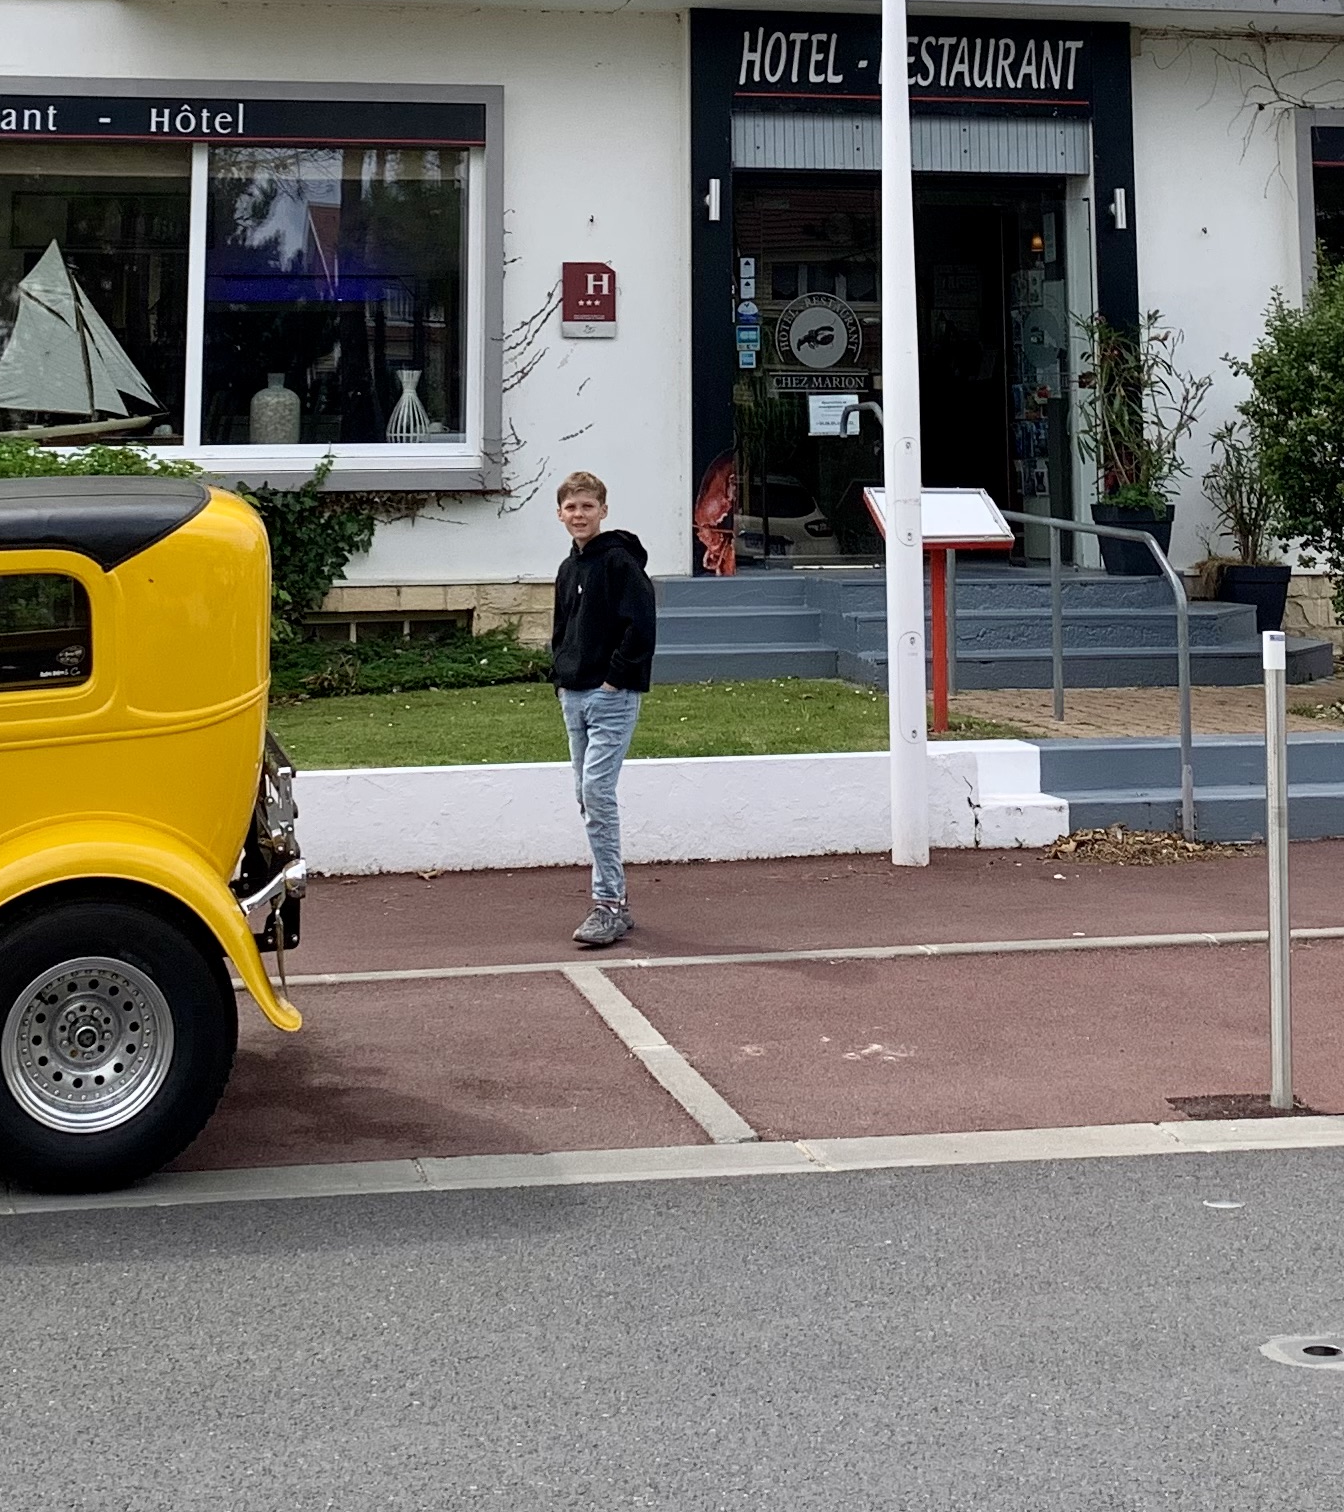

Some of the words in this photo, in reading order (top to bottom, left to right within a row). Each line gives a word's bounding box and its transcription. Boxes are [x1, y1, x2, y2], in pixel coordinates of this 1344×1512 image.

[739, 27, 844, 85] HOTEL
[878, 35, 1084, 90] ESTAURANT
[150, 103, 245, 134] Hôtel
[585, 273, 610, 295] H
[779, 309, 799, 351] HOTEL
[804, 296, 858, 353] RESTAURANT
[773, 376, 808, 388] CHEZ
[811, 376, 865, 388] MARION
